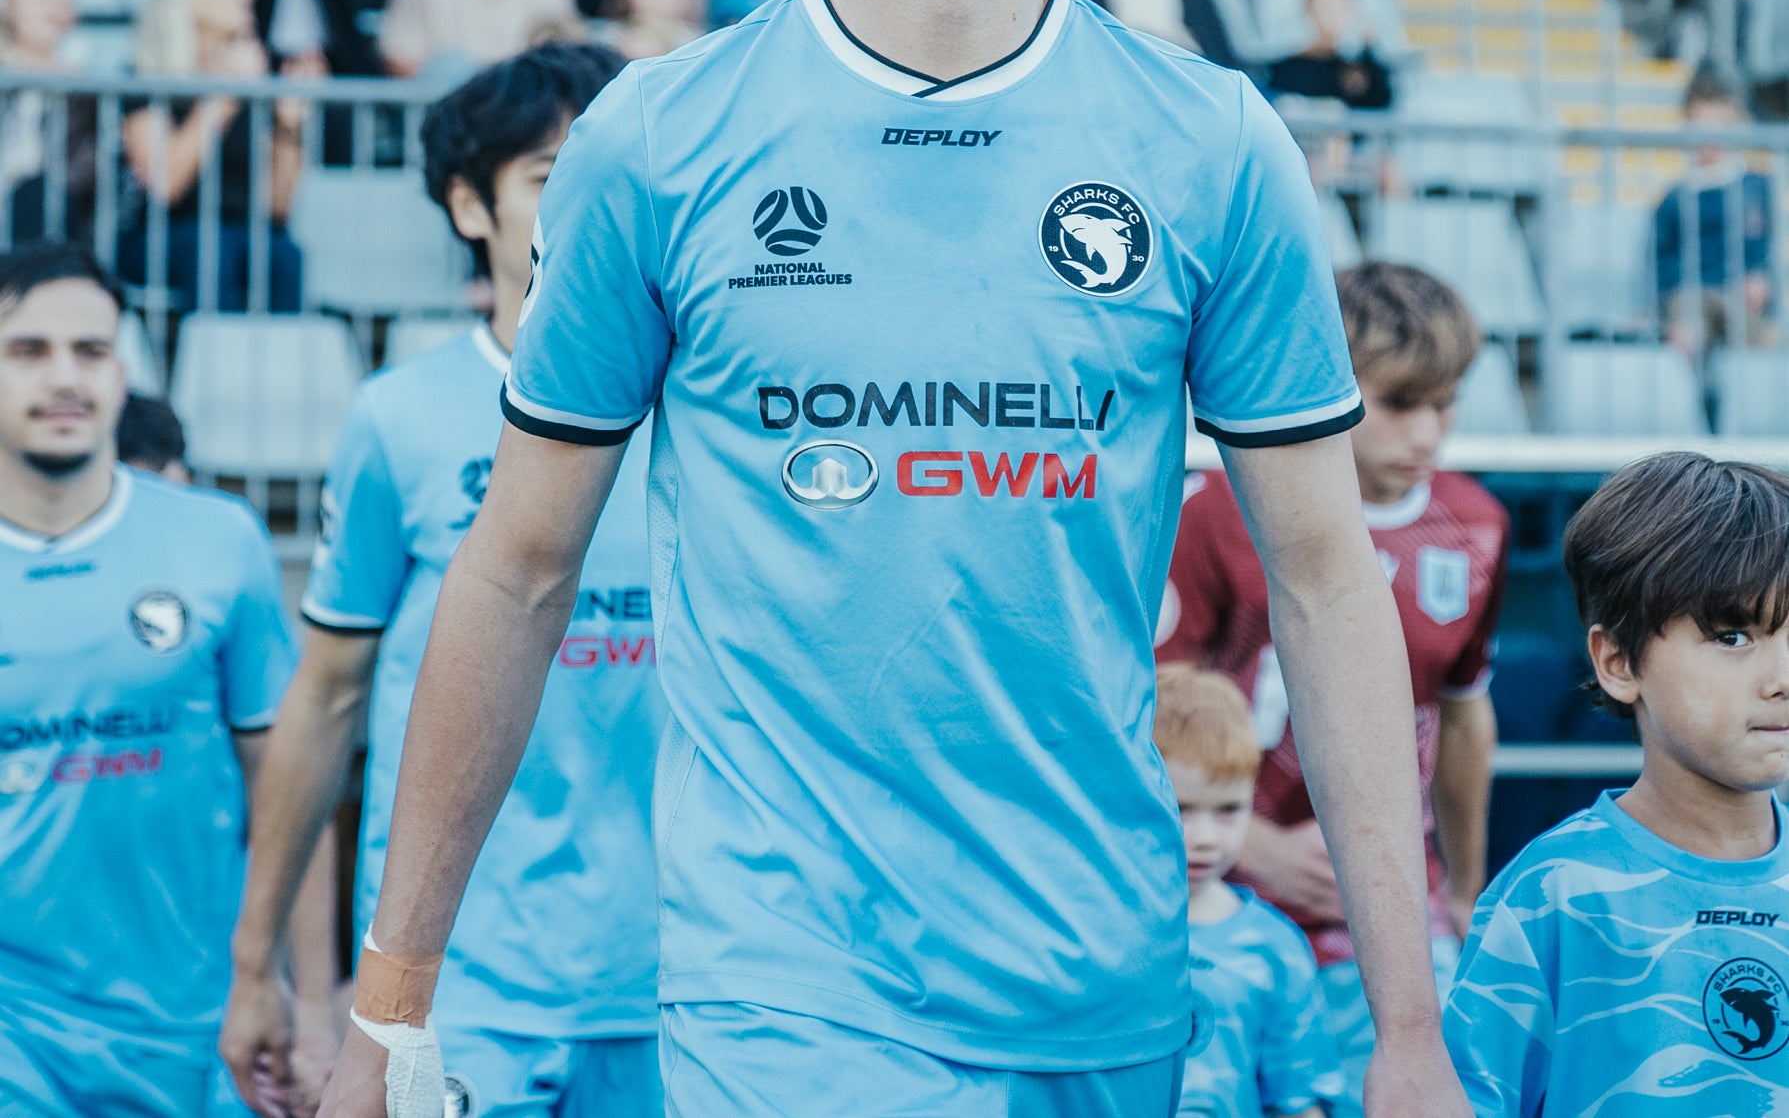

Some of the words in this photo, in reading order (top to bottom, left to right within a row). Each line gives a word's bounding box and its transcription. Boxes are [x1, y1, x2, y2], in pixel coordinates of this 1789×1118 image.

[881, 127, 1003, 147] DEPLOY
[1053, 188, 1120, 218] SHARKS
[1121, 202, 1141, 226] FC
[728, 274, 788, 289] PREMIER
[789, 273, 853, 286] LEAGUES
[754, 262, 826, 275] NATIONAL
[757, 380, 1116, 433] DOMINELLI
[896, 450, 1098, 500] GWM
[560, 636, 656, 667] GW
[1695, 910, 1781, 927] DEPLOY
[1713, 964, 1766, 993] SHARKS
